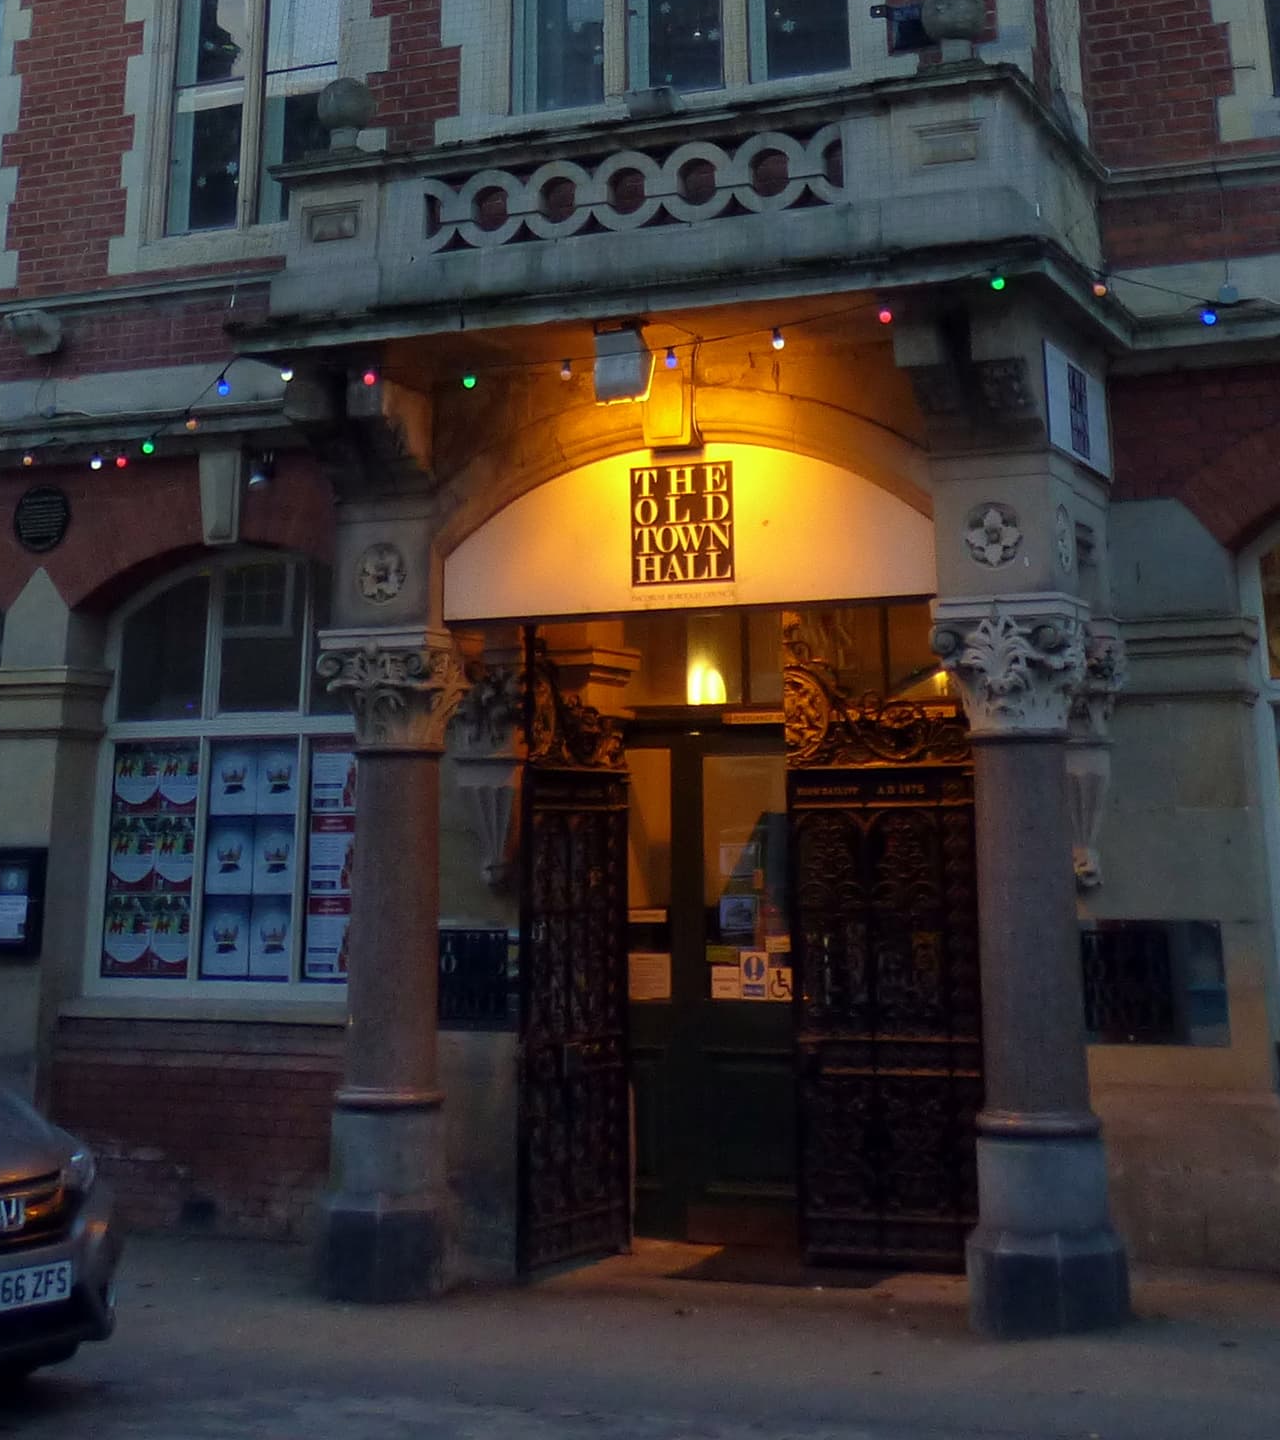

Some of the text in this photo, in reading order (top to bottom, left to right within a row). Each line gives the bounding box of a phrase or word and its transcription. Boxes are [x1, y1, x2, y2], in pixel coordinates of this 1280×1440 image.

[634, 464, 728, 497] THE
[634, 493, 729, 525] OLD
[634, 522, 732, 555] TOWN
[635, 551, 732, 583] HALL
[31, 1267, 68, 1299] ZFS
